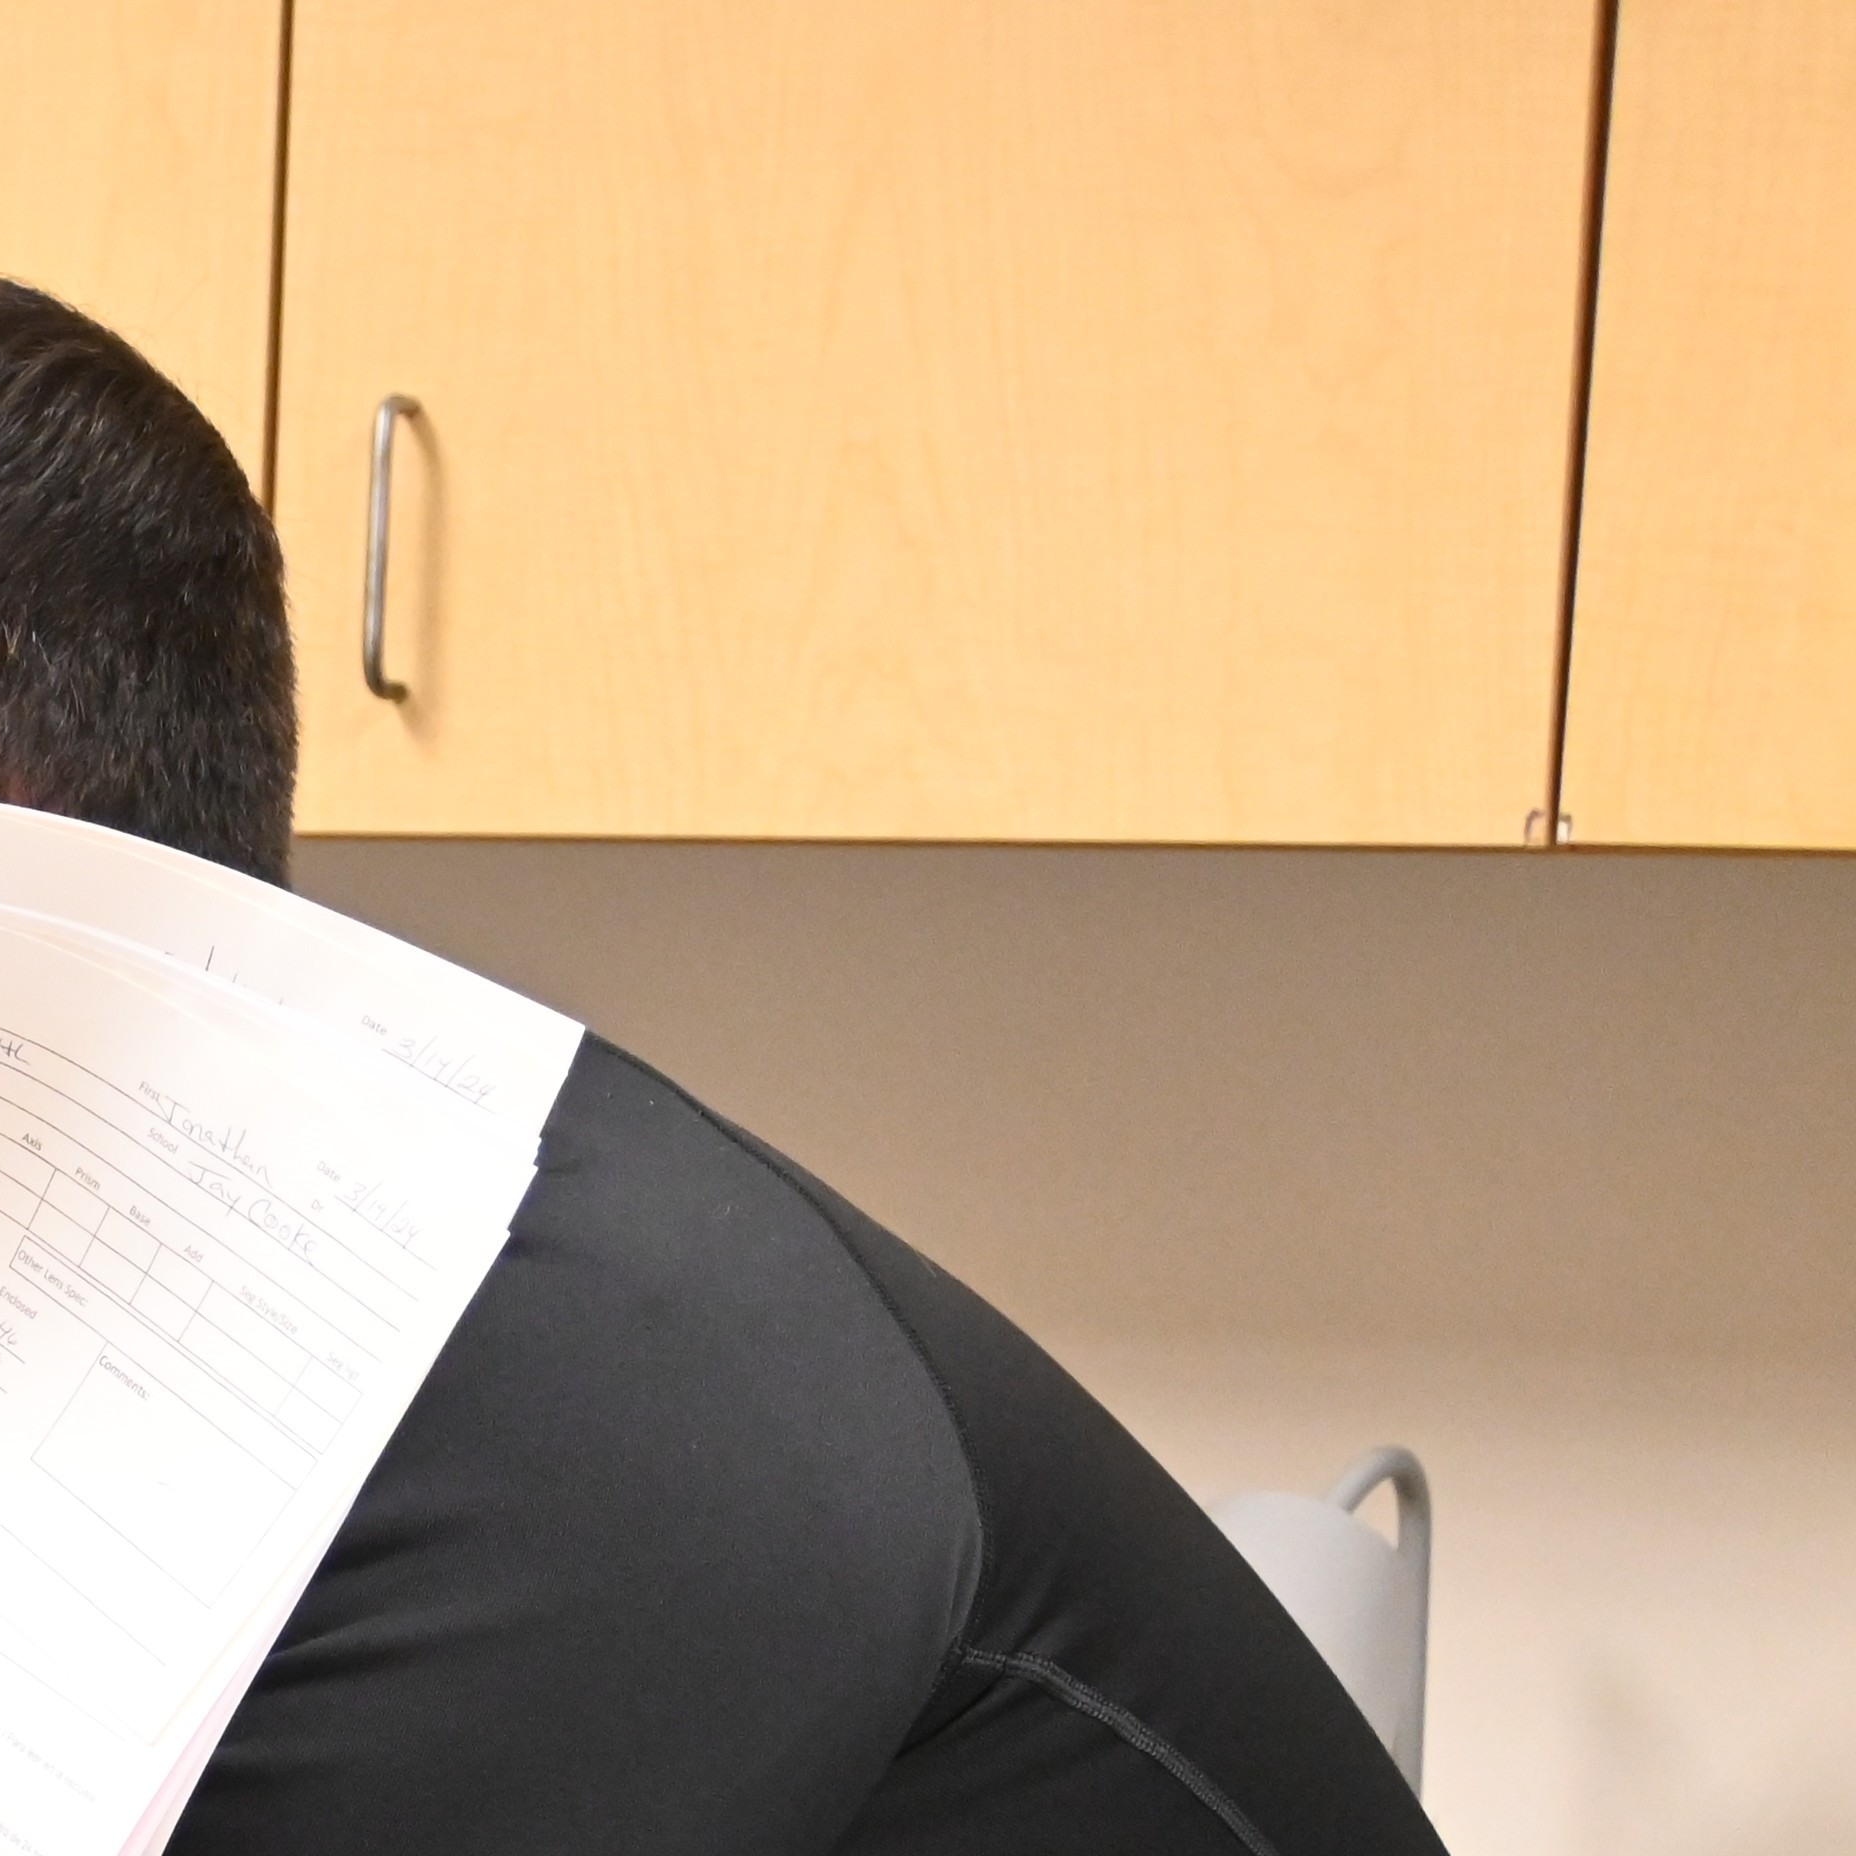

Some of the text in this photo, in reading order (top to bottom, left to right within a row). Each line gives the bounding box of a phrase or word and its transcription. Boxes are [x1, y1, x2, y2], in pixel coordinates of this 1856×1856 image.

[361, 1014, 388, 1036] Date
[21, 1131, 42, 1151] Axis
[146, 1127, 179, 1155] School
[74, 1166, 101, 1191] Prism
[316, 1160, 342, 1183] Date
[128, 1205, 151, 1227] Base
[184, 1244, 203, 1263] Add
[17, 1249, 43, 1272] Other
[42, 1270, 64, 1290] Lens
